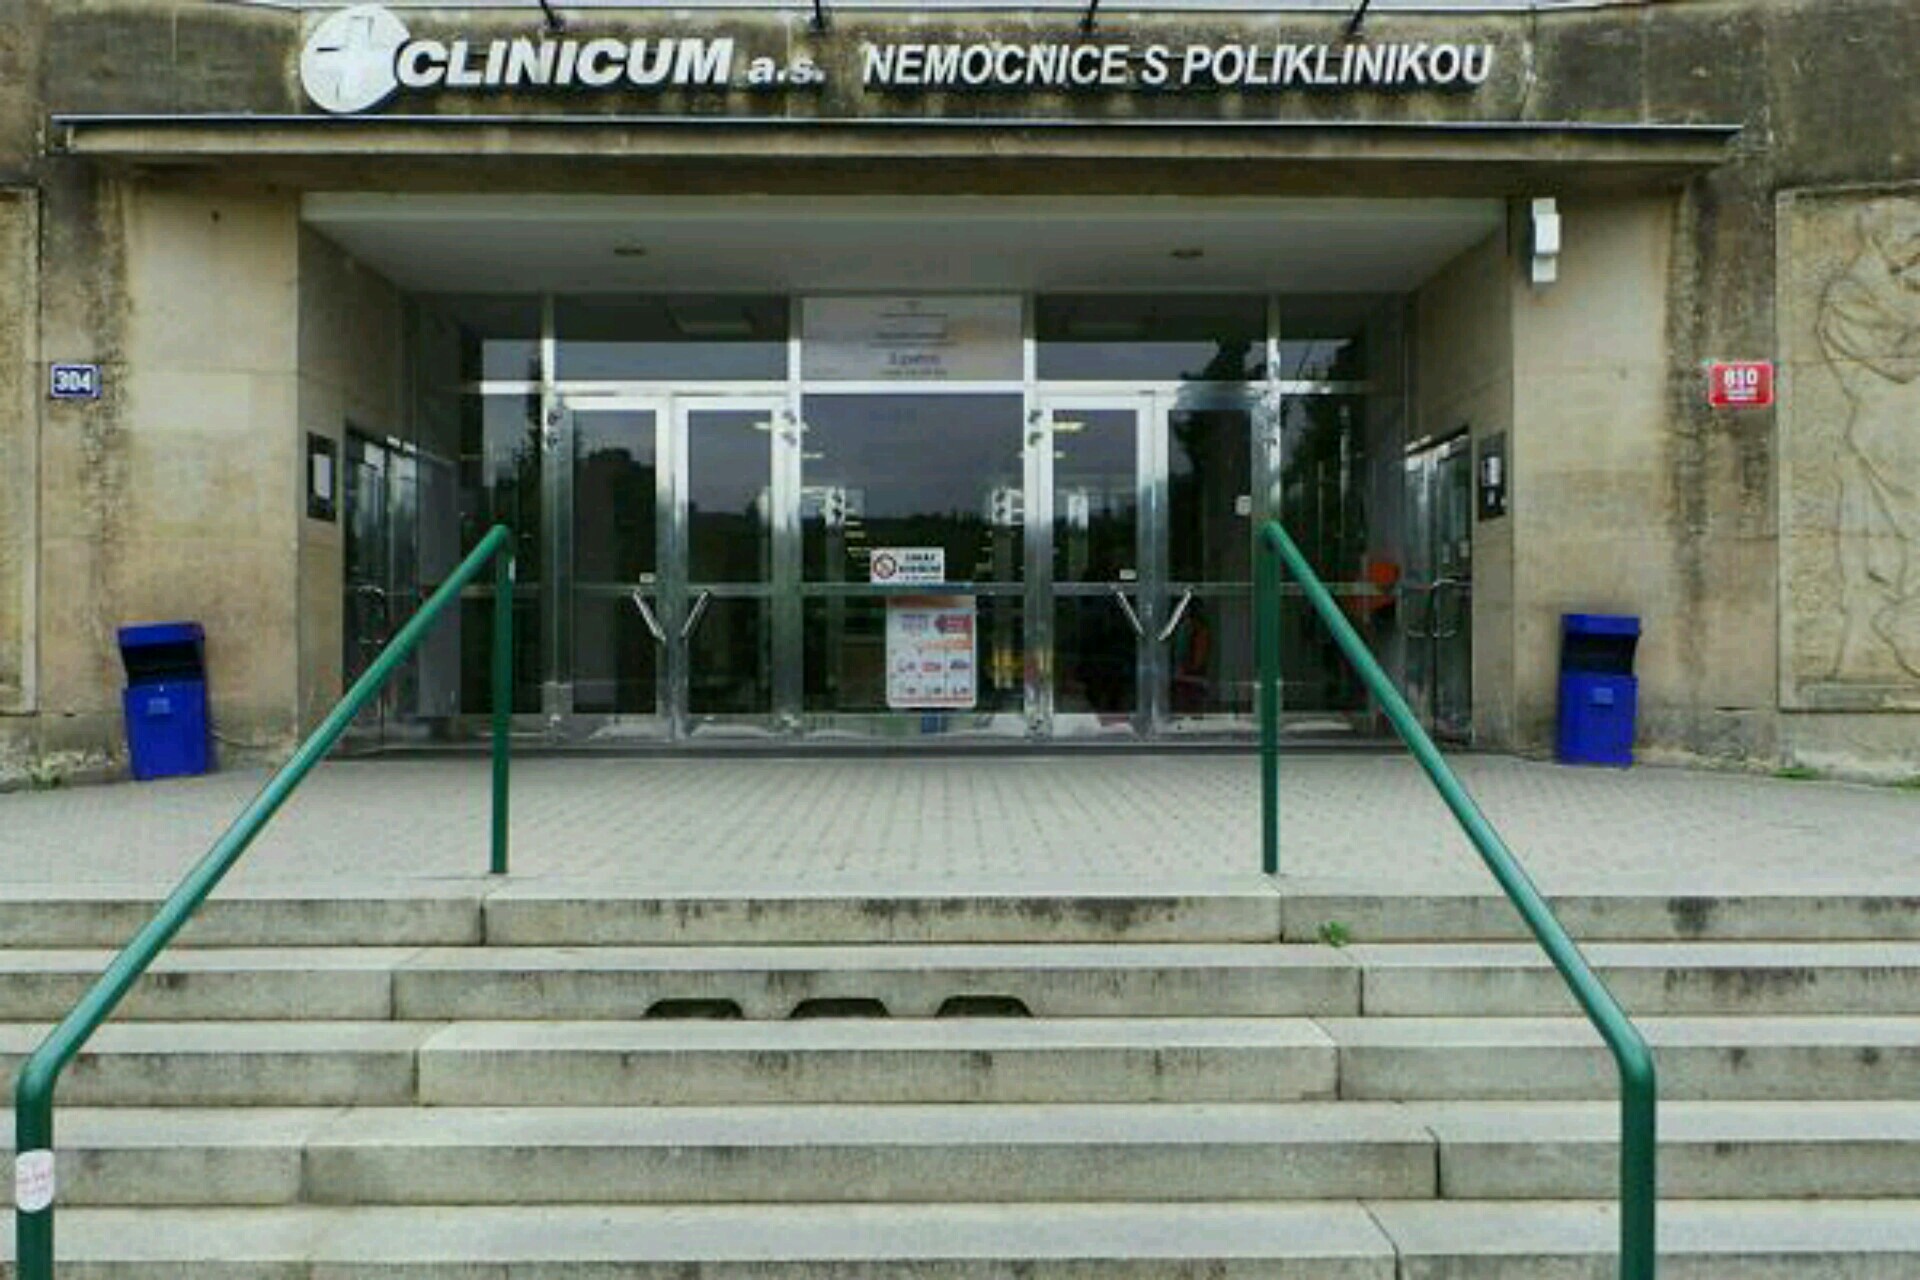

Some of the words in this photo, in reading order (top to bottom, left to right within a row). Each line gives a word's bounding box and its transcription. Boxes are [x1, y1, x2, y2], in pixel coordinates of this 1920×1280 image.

[397, 37, 734, 86] CLINICUM
[746, 53, 824, 84] a.s.
[859, 42, 1130, 85] NEMOCNICE
[1142, 44, 1170, 84] S
[1182, 42, 1494, 84] POLIKLINIKOU
[56, 370, 91, 391] 304
